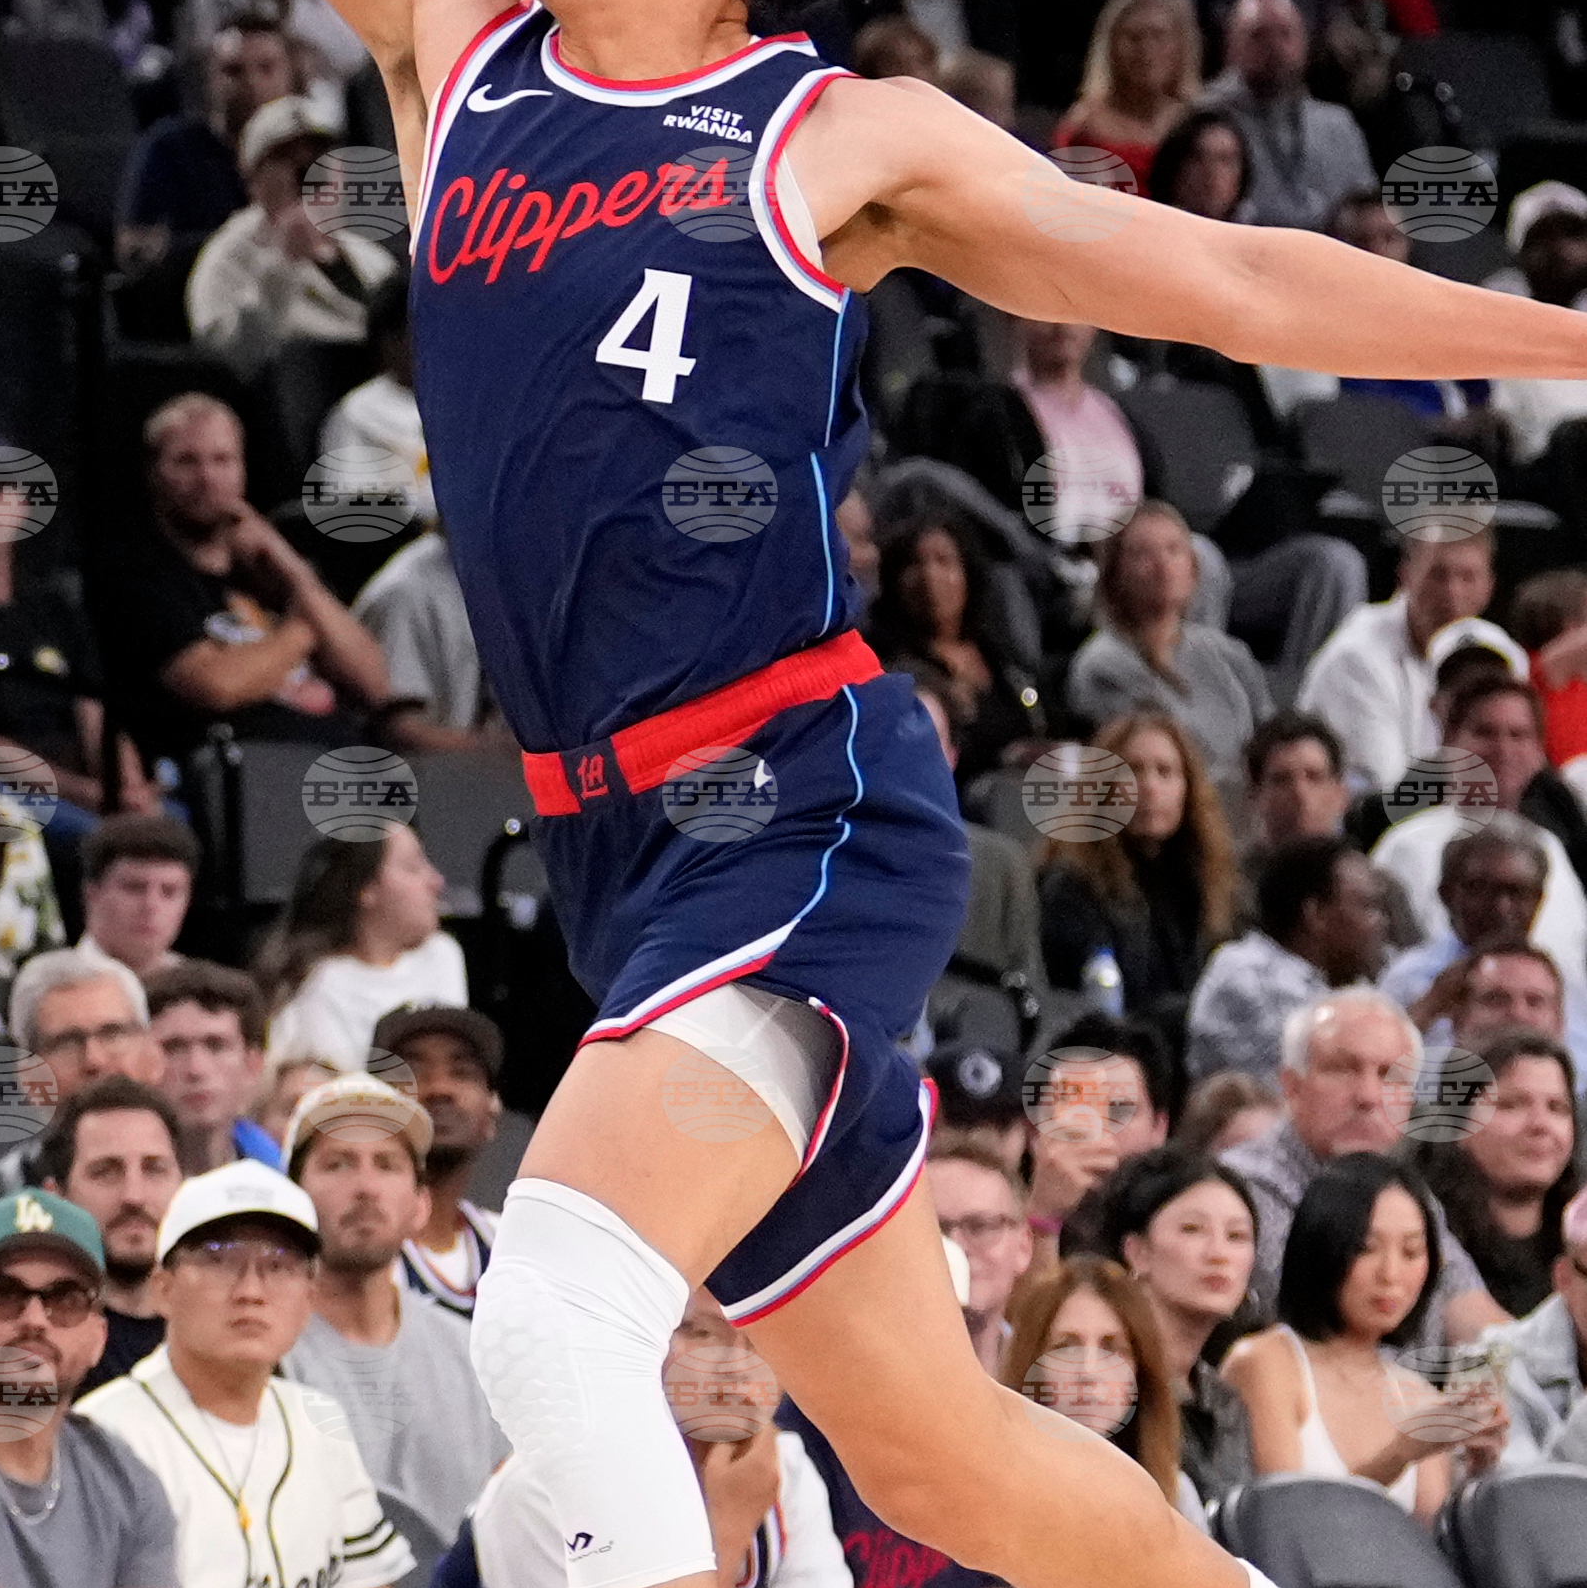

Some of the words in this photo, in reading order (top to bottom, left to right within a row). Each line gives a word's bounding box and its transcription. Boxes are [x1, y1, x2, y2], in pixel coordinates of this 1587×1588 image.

[663, 114, 752, 144] RWANDA
[691, 105, 743, 127] VISIT
[428, 157, 735, 286] Clippers
[595, 268, 697, 404] 4
